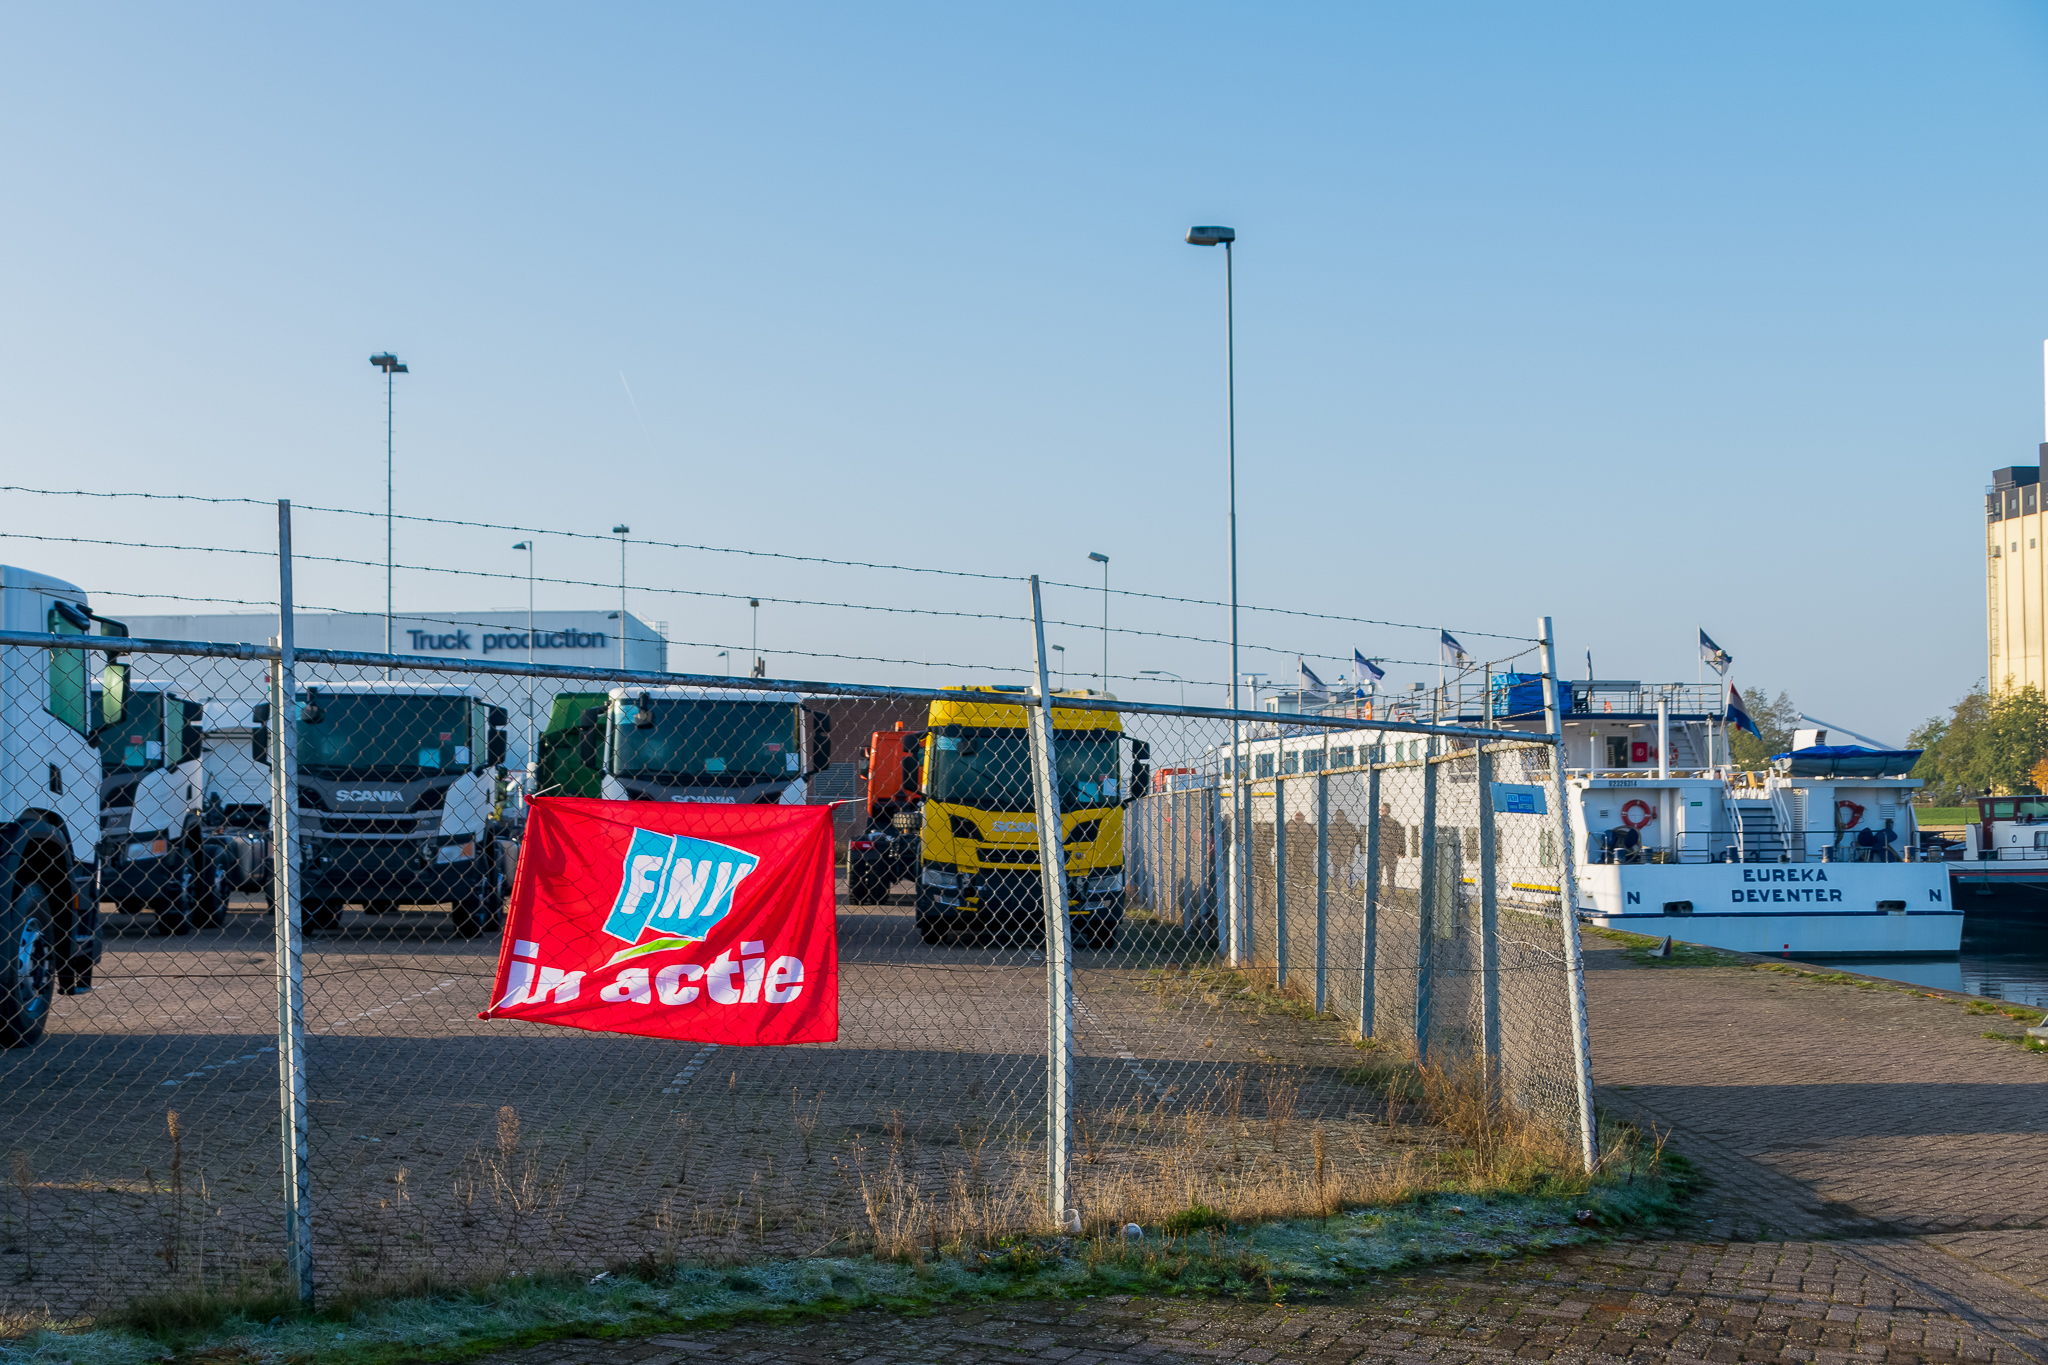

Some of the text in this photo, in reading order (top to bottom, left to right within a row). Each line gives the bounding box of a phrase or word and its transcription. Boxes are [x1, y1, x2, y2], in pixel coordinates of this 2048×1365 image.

[406, 628, 606, 654] Truck production
[335, 789, 404, 802] SCANIA
[992, 820, 1038, 833] SCAN
[1743, 868, 1829, 882] EUREKA
[620, 854, 753, 920] FNV
[1626, 891, 1641, 904] N
[1731, 888, 1843, 902] DEVENTER
[1929, 888, 1942, 902] N
[500, 939, 805, 1009] in actie
